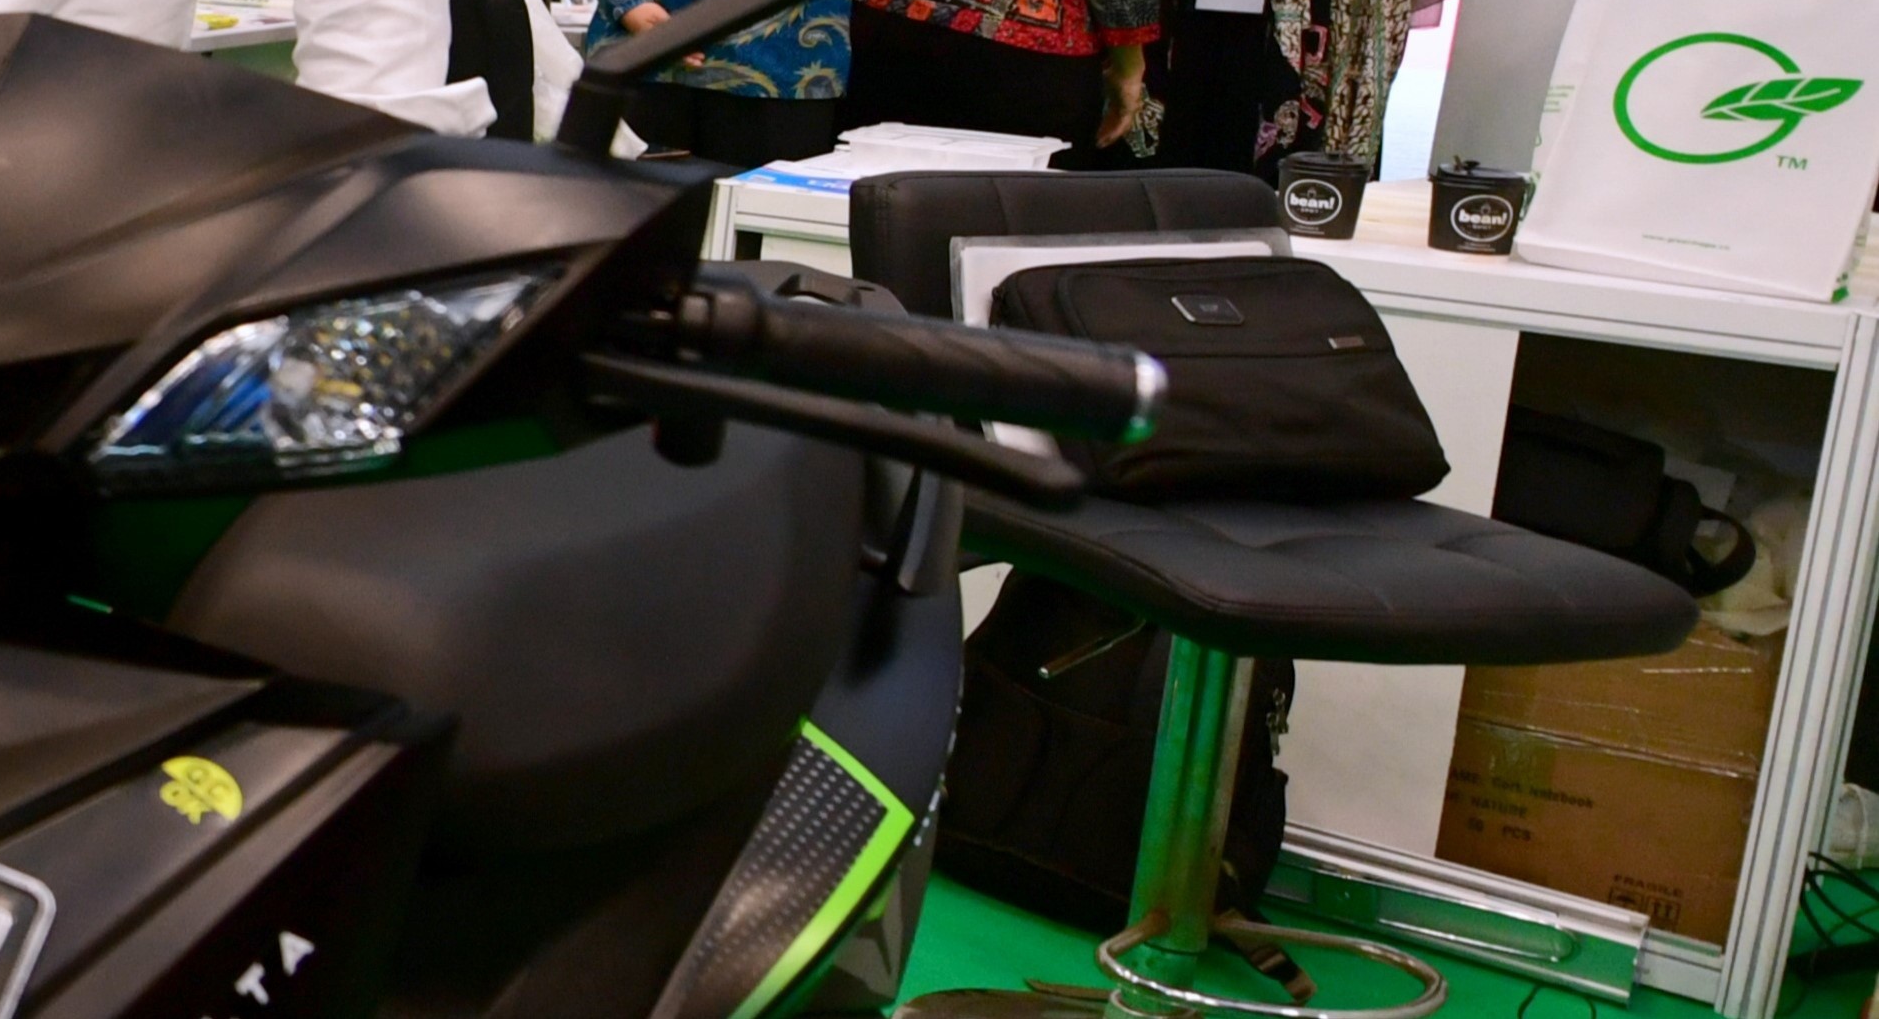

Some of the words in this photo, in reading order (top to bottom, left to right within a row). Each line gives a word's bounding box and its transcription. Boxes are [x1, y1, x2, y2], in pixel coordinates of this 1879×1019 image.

[1776, 154, 1809, 171] TM
[1289, 192, 1336, 211] bean!
[1458, 208, 1508, 226] bean!
